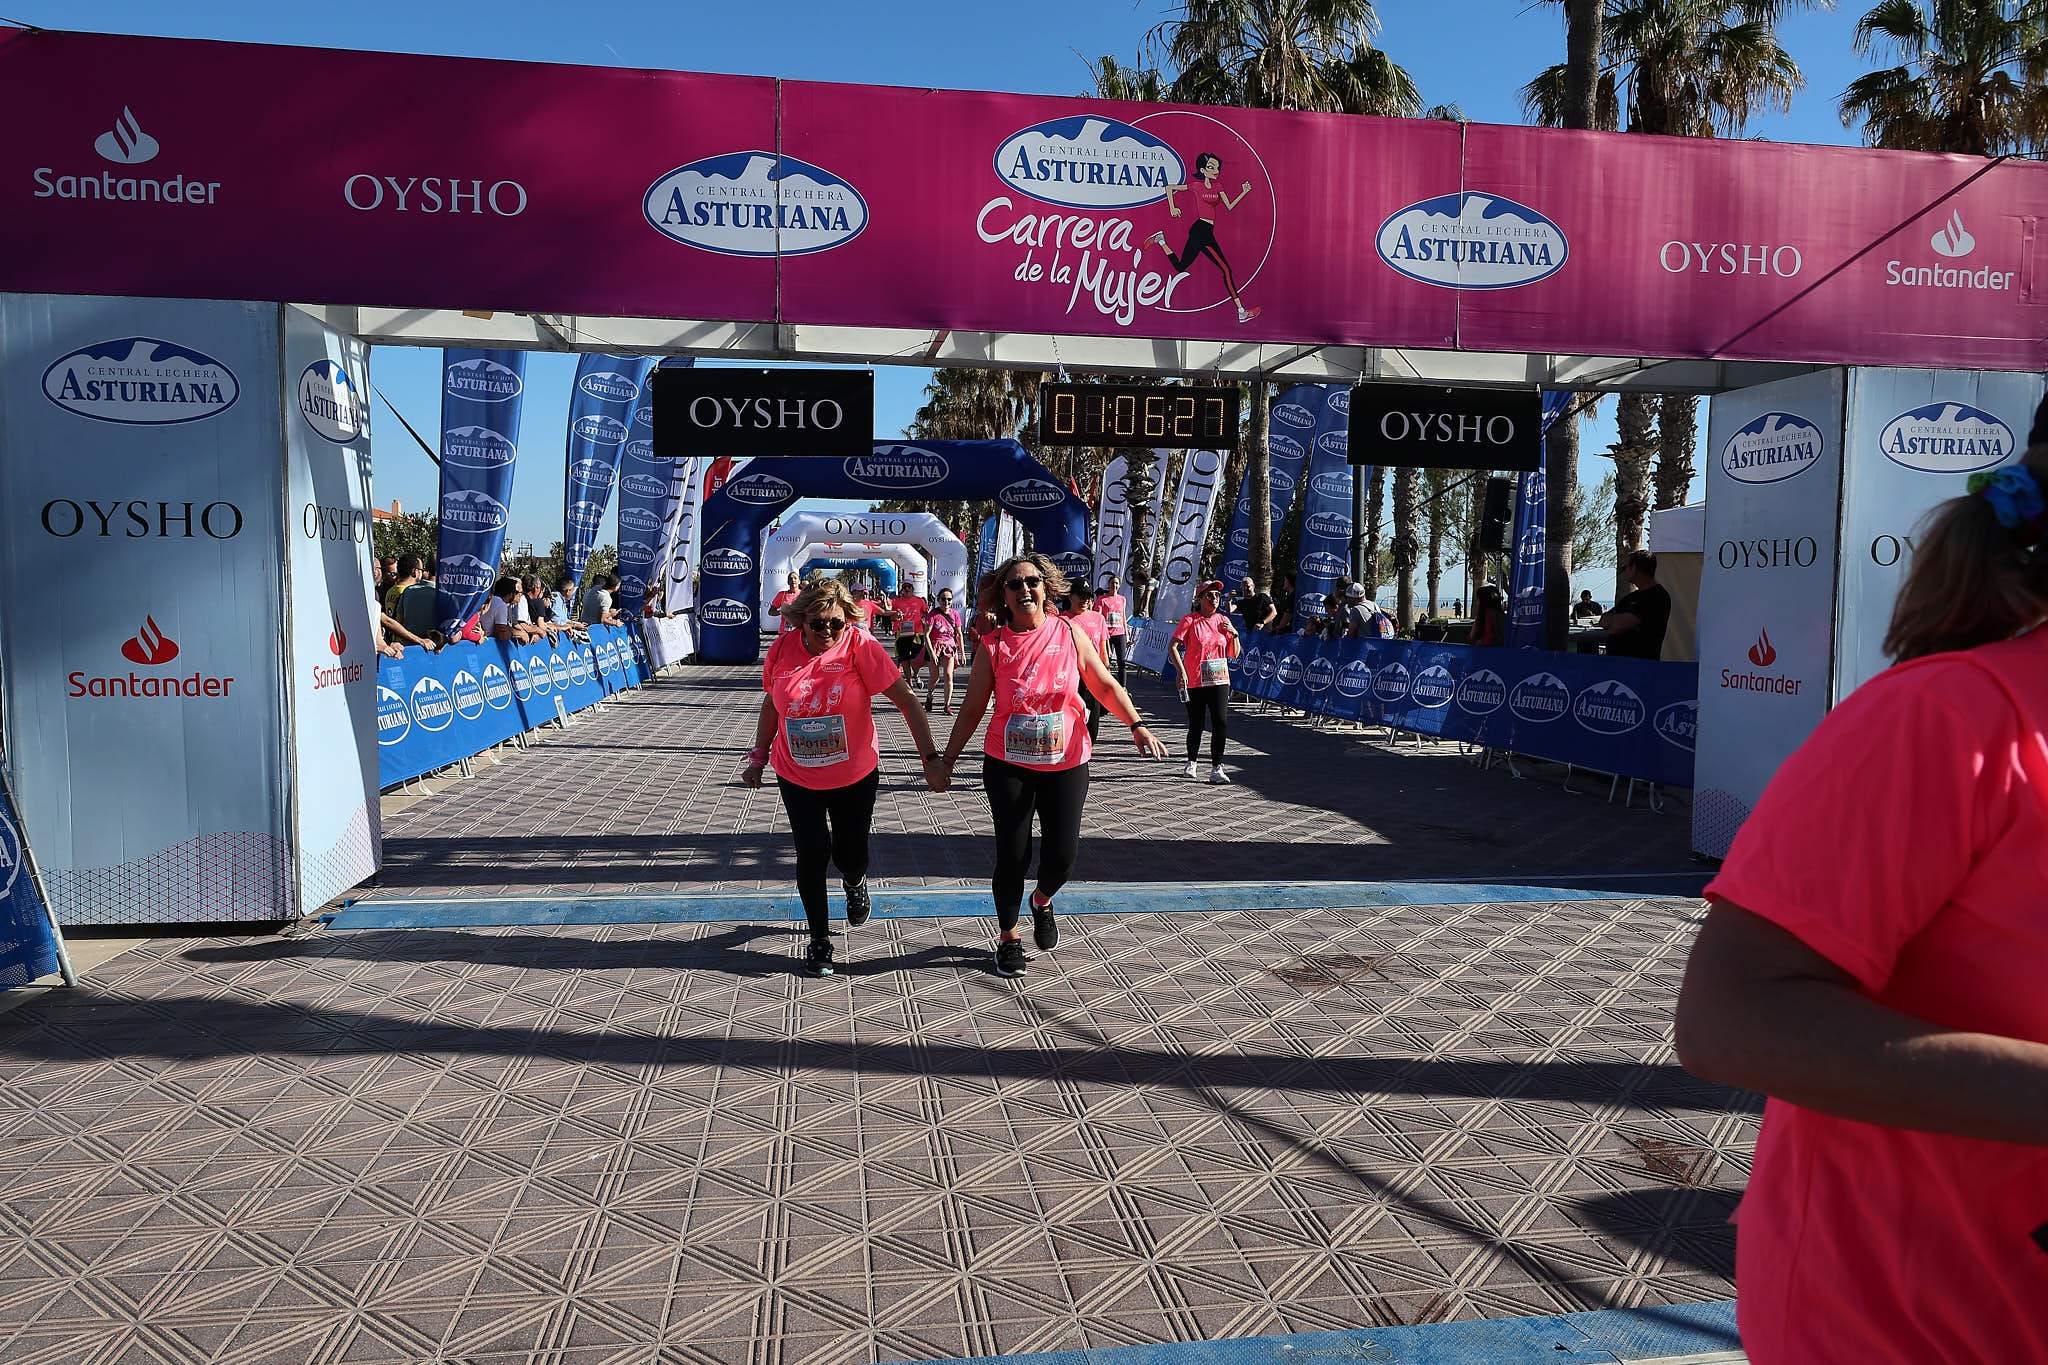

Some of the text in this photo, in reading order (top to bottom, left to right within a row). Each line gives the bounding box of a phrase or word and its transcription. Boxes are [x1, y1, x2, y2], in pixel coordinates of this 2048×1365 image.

[1008, 145, 1170, 188] ASTURIANA
[1039, 144, 1165, 161] CENTRAL LECHERA
[33, 167, 221, 205] Santander
[343, 173, 528, 217] OYSHO
[696, 185, 766, 198] CENTRAL
[660, 186, 852, 231] ASTURIANA
[976, 196, 1133, 252] Carrera
[1421, 223, 1548, 238] CENTRAL LECHERA
[1390, 224, 1553, 266] ASTURIANA
[1659, 239, 1803, 279] OYSHO
[1014, 247, 1191, 326] de la Mujer
[1886, 260, 2014, 291] Santander
[58, 367, 226, 404] ASTURIANA
[87, 366, 219, 379] CENTRAL LECHERA
[303, 380, 360, 429] ASTURIANA
[690, 396, 843, 430] OYSHO
[1380, 410, 1515, 445] OYSHO
[1742, 431, 1812, 448] CENTRAL LECHERA
[1888, 427, 2004, 456] ASTURIANA
[1910, 426, 2001, 436] CENTRAL LECHERA
[852, 459, 941, 479] ASTURIANA
[1727, 441, 1815, 471] ASTURIANA
[731, 484, 788, 498] ASTURIANA
[1003, 489, 1061, 503] ASTURIANA
[41, 498, 243, 539] OYSHO
[304, 502, 366, 544] OYSHO
[825, 517, 906, 536] OYSHO
[1166, 450, 1220, 585] OYSHO
[703, 559, 749, 570] ASTURIANA
[1718, 535, 1817, 569] OYSHO
[703, 608, 748, 620] ASTURIANA
[68, 671, 235, 698] Santander
[313, 661, 364, 690] Santander
[1374, 677, 1406, 693] ASTURIANA
[1413, 678, 1451, 699] ASTURIANA
[1720, 668, 1802, 696] Santander
[1458, 684, 1501, 706] ASTURIANA
[1512, 689, 1564, 713] ASTURIANA
[377, 710, 409, 732] TURIANA
[416, 699, 453, 721] ASTURIANA
[1576, 695, 1637, 726] ASTURIANA
